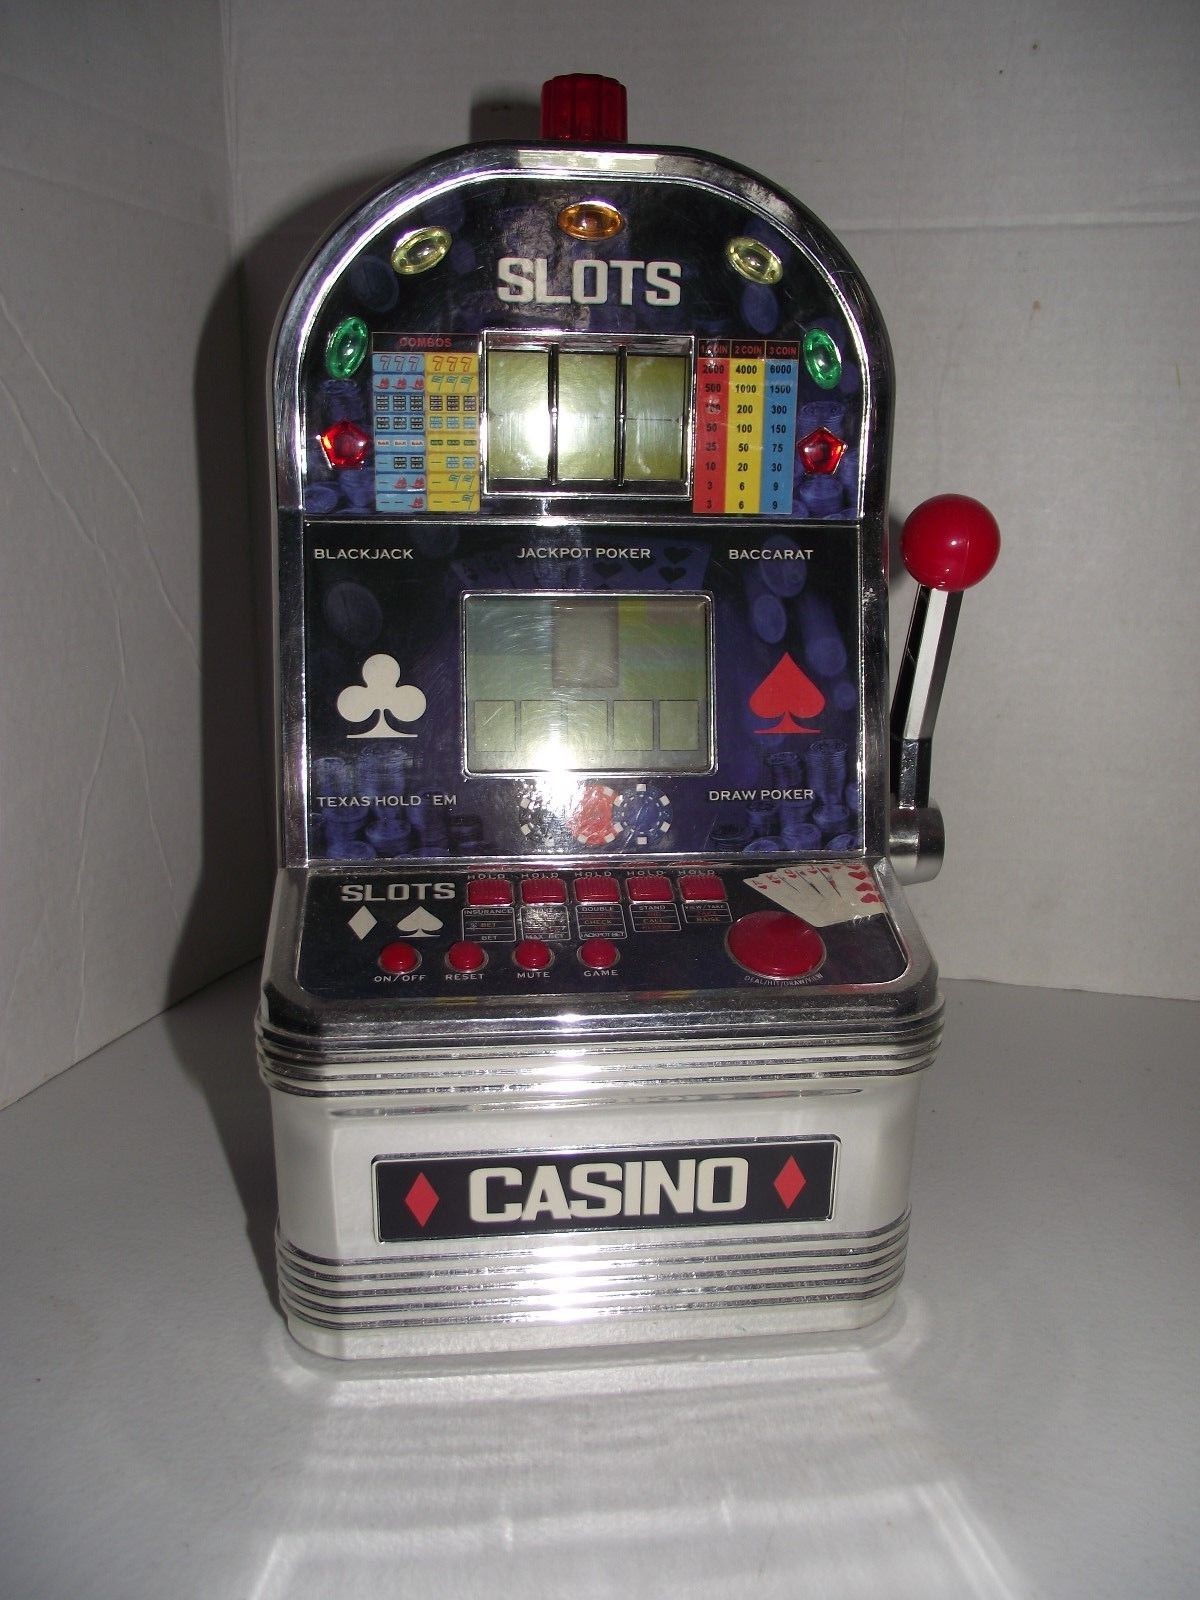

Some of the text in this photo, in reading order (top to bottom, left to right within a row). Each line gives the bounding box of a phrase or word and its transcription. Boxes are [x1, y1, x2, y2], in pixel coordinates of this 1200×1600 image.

[497, 257, 682, 306] SLOTS
[742, 346, 762, 354] COIN
[775, 347, 797, 355] COIN
[735, 365, 757, 375] 4000
[770, 365, 792, 375] 6000
[705, 384, 721, 393] 500
[735, 384, 757, 393] 1000
[770, 385, 791, 394] 1500
[737, 404, 753, 414] 200
[771, 405, 787, 415] 300
[706, 423, 717, 432] 50
[736, 424, 752, 433] 100
[771, 424, 787, 434] 150
[738, 443, 749, 452] 50
[772, 443, 783, 452] 75
[705, 461, 716, 471] 10
[737, 462, 748, 472] 20
[771, 463, 782, 472] 30
[707, 481, 713, 490] 3
[739, 482, 745, 491] 6
[773, 482, 779, 491] 9
[706, 500, 712, 509] 3
[739, 500, 744, 509] 6
[772, 500, 778, 509] 9
[314, 548, 414, 560] BLACKJACK
[517, 547, 651, 559] JACKPOT POKER
[729, 549, 814, 560] BACCARAT
[709, 789, 814, 801] DRAW POKER
[316, 796, 371, 807] TEXAS
[375, 795, 422, 807] HOLD
[341, 882, 456, 902] SLOTS
[445, 973, 485, 981] RESET
[517, 971, 551, 979] MUTE
[583, 969, 619, 977] GAME
[373, 974, 427, 982] ON/OFF
[468, 1156, 749, 1224] CASINO
